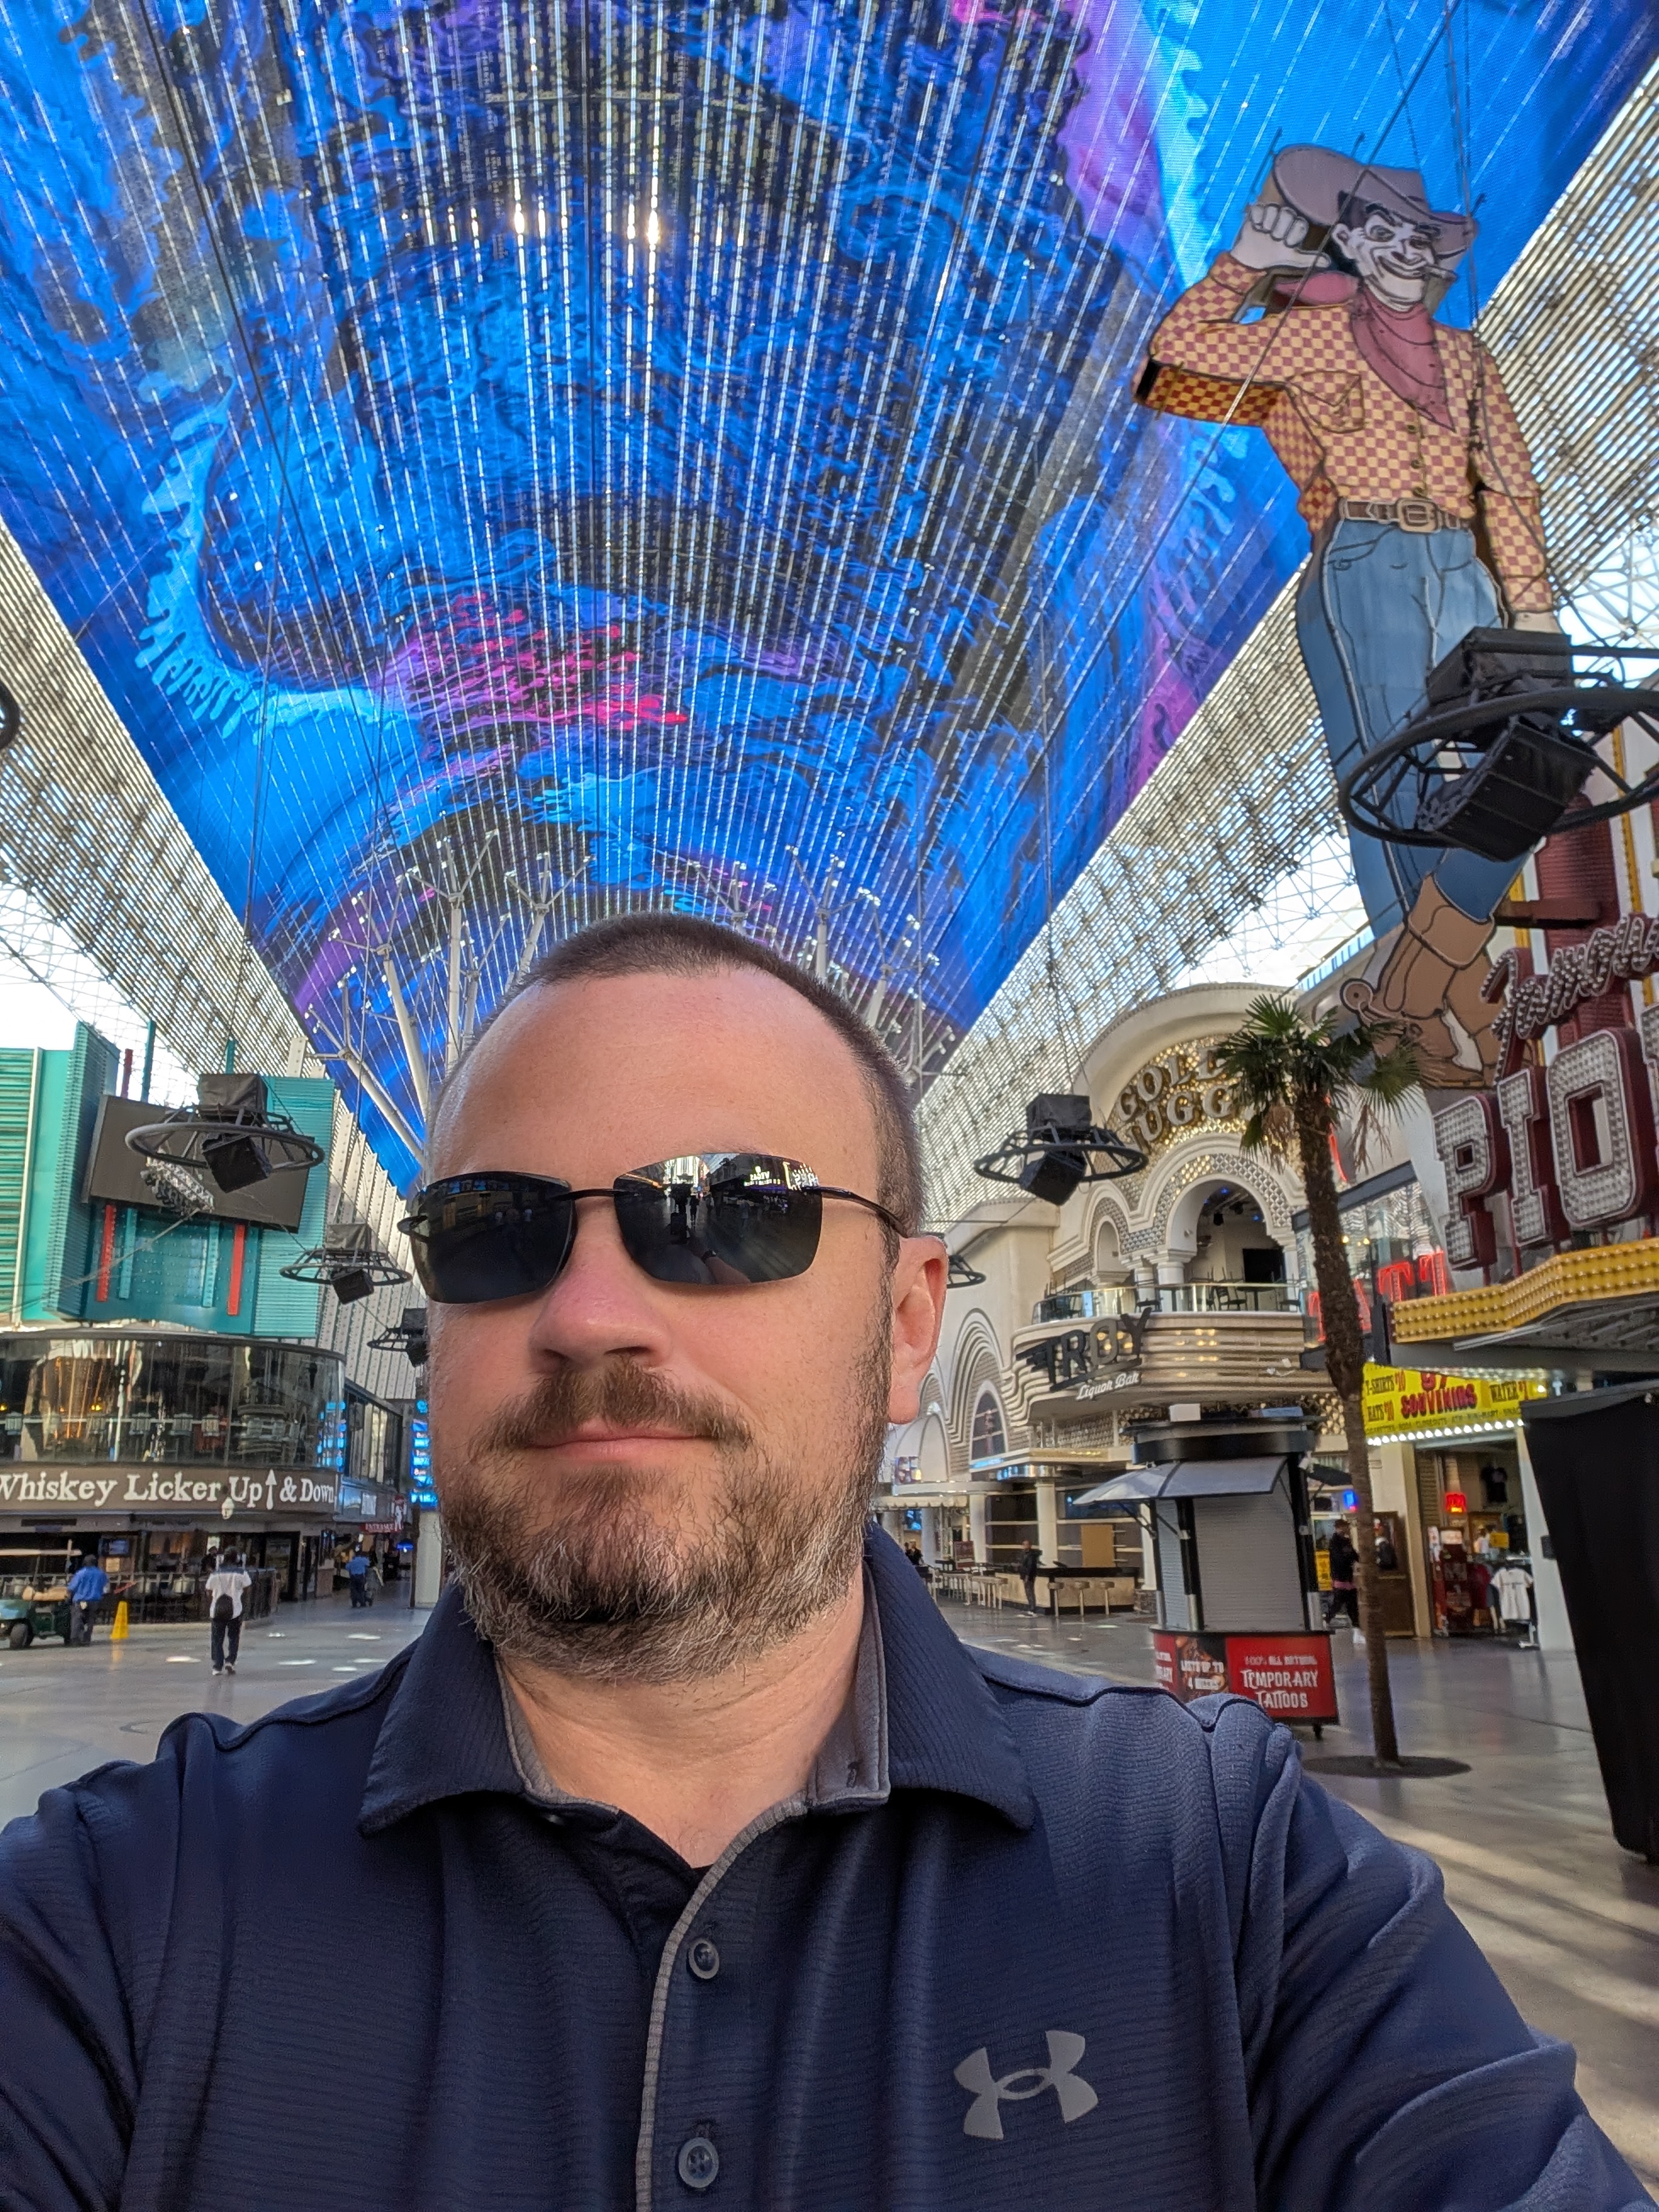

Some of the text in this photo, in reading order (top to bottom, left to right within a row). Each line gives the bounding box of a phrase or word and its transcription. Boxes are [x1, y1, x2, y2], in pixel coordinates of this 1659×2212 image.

[1432, 1000, 1659, 1269] PIO
[1016, 1307, 1152, 1387] TROY
[1076, 1370, 1140, 1400] Liquor Bar
[1401, 1383, 1478, 1419] SOUVENIRS
[0, 1471, 334, 1509] Whiskey Licker Up & Down
[1212, 1661, 1225, 1674] TO
[1240, 1669, 1318, 1689] TEMPORARY
[1255, 1691, 1309, 1709] TATTOOS
